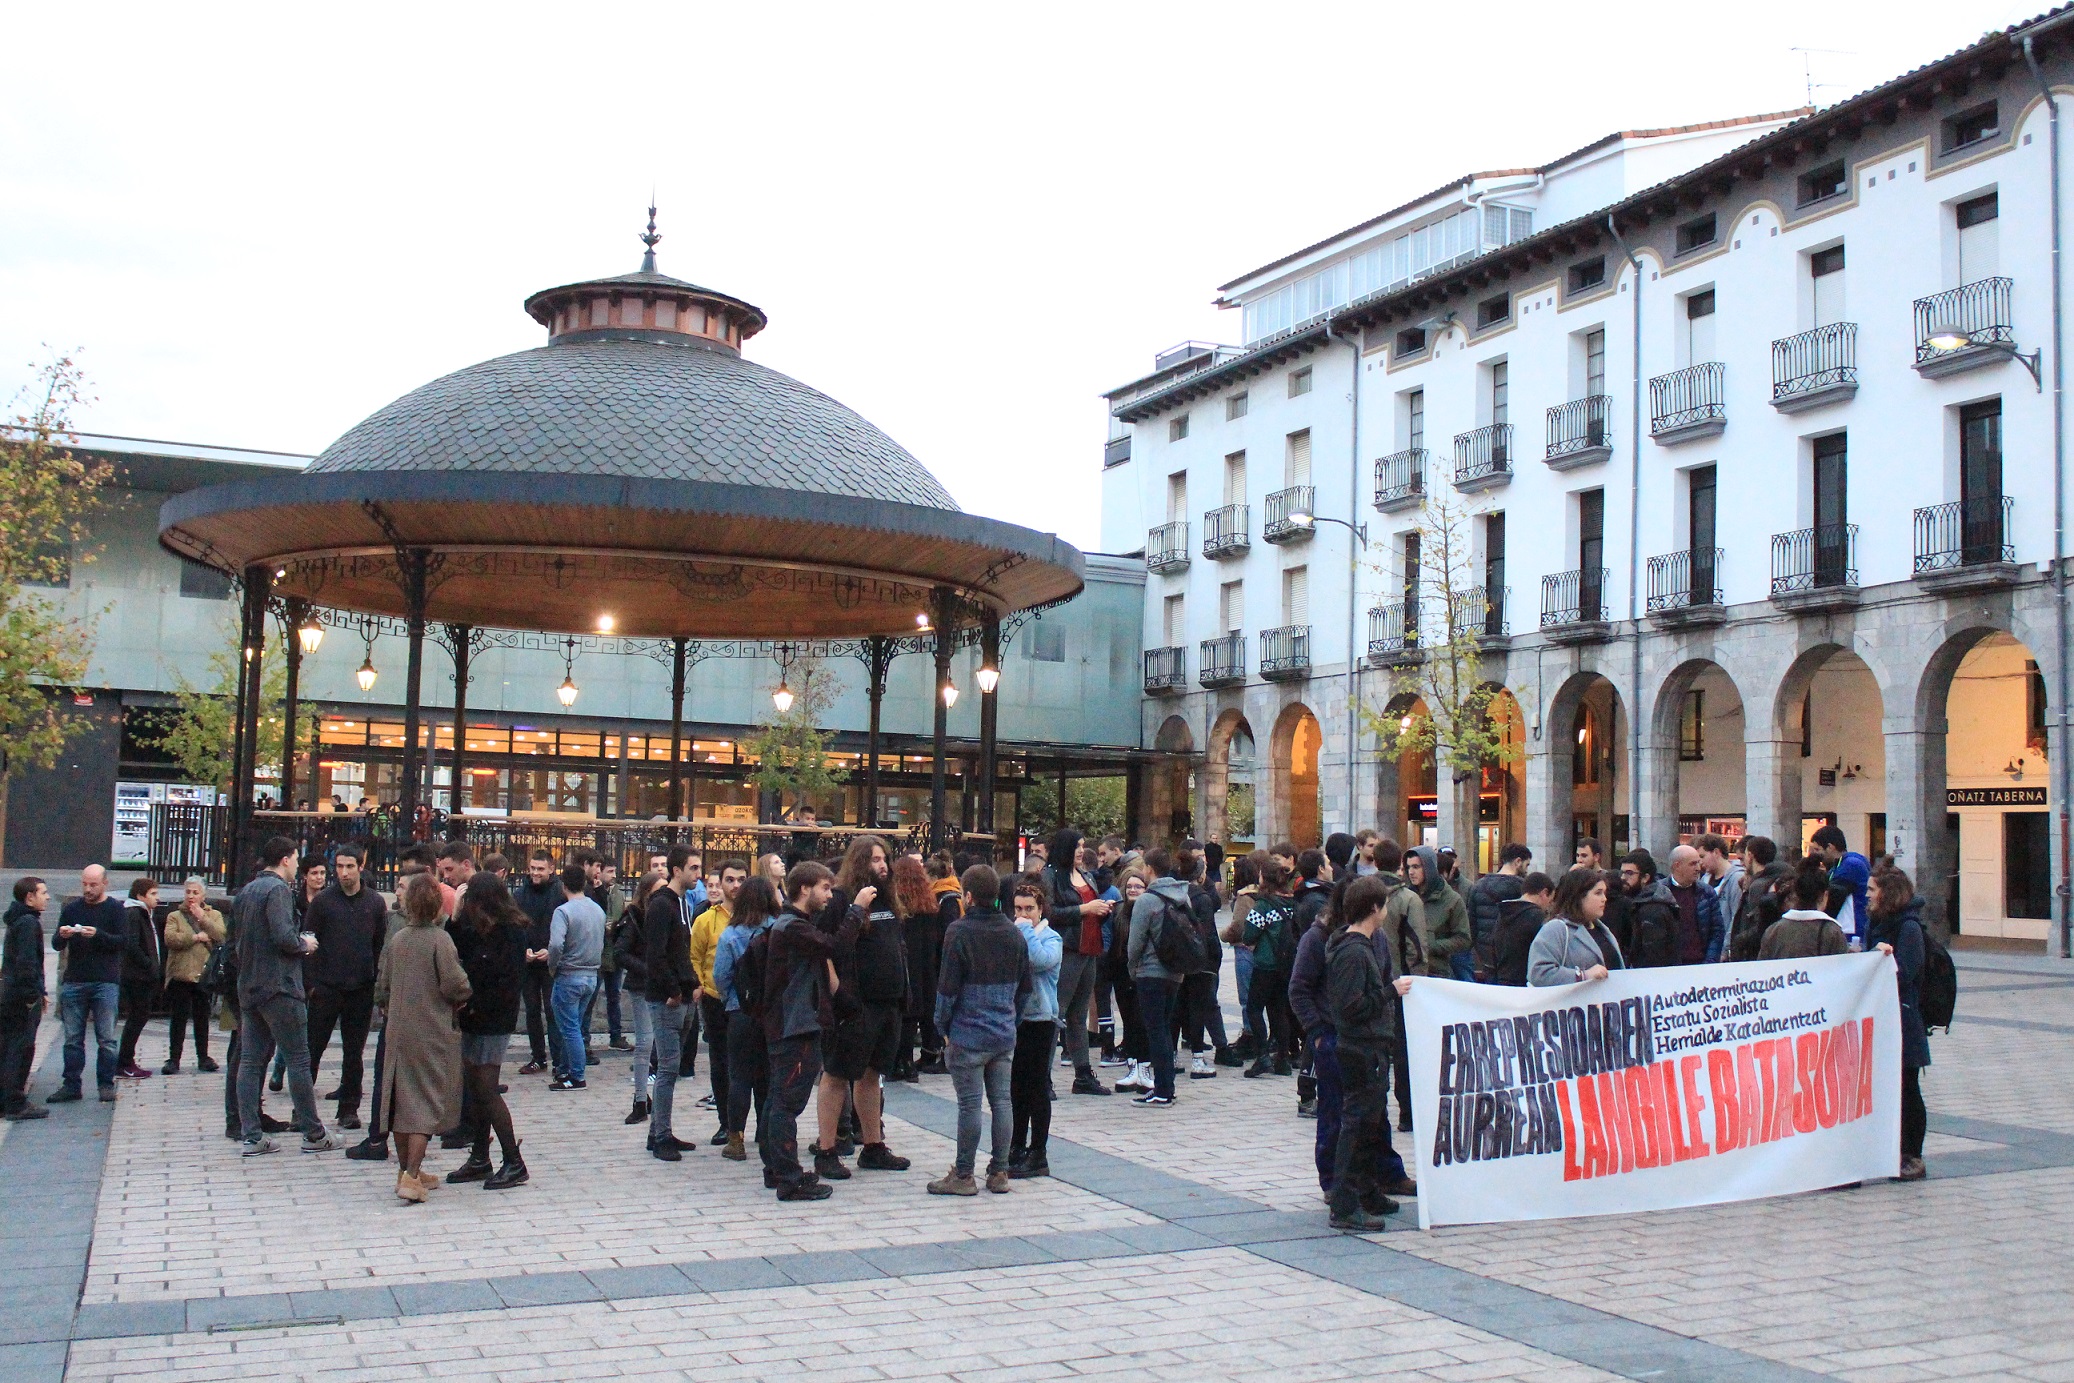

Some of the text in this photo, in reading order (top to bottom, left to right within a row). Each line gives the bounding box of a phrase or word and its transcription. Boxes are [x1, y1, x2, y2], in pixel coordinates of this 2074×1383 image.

[1948, 790, 2044, 803] OÑATZ TABERNA
[1652, 969, 1812, 1012] Autodeterminazioa eta
[1652, 996, 1769, 1033] Estatu Sozialista
[1655, 1007, 1827, 1054] Herrialde Katalanentzat
[1439, 994, 1655, 1096] ERREPRESIOAREN
[1433, 1016, 1874, 1182] AURREAN LANGILE BATASUNA
